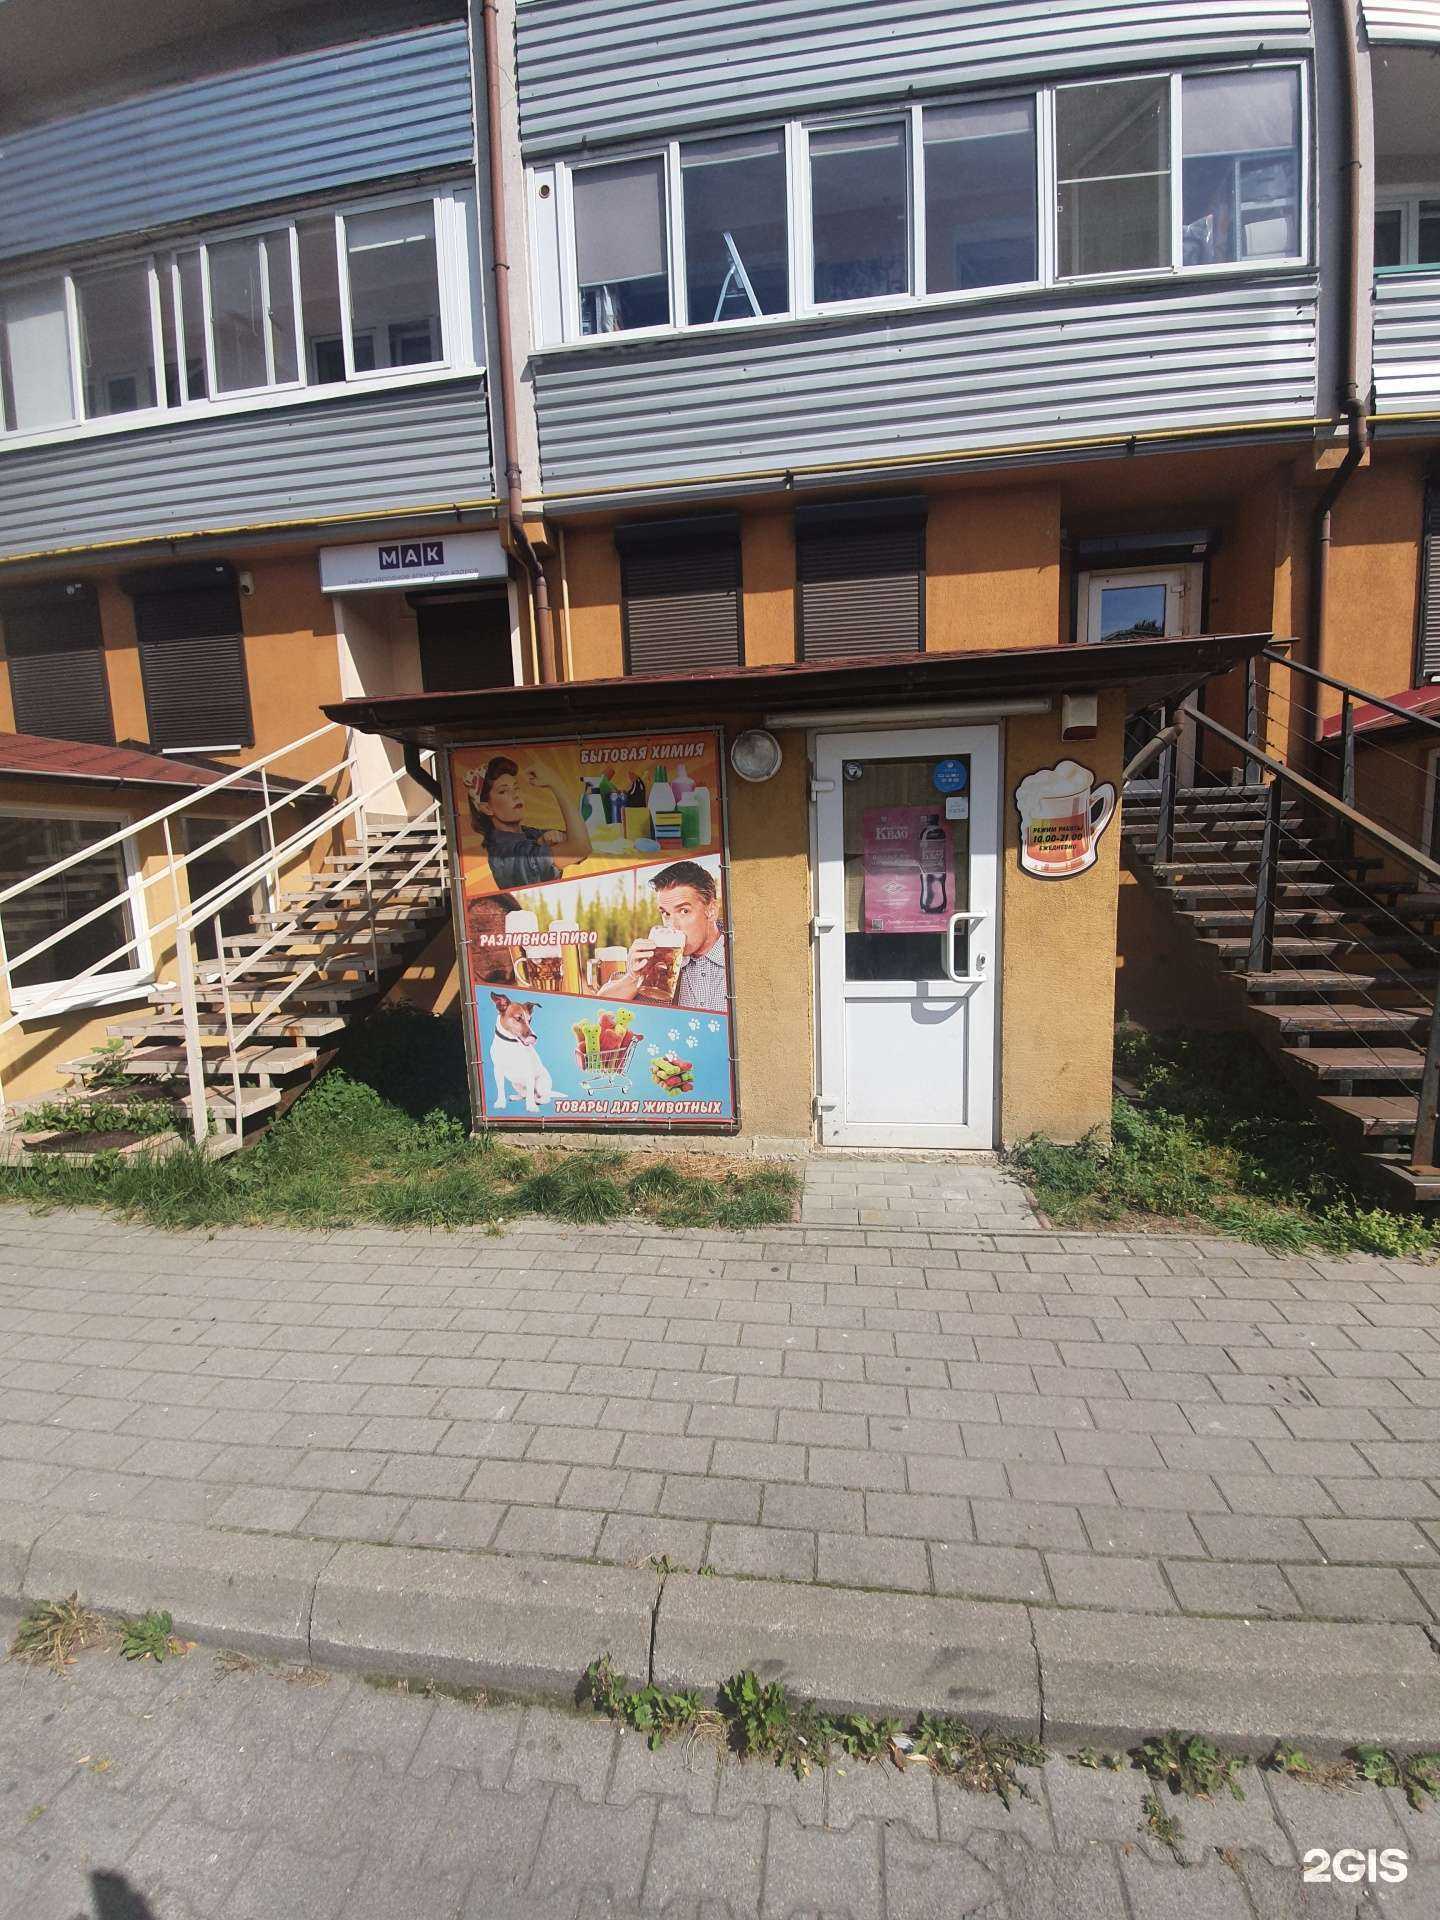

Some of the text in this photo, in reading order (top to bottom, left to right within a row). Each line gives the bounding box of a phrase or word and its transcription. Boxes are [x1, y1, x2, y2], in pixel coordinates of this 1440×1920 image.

[381, 547, 439, 566] МАК
[581, 742, 705, 764] БЫТОВАЯ ХИМИЯ
[479, 930, 598, 947] РАЗЛИВНОЕ ПИВО
[554, 1100, 722, 1114] ТОВАРЫ ДЛЯ ЖИВОТНЫХ
